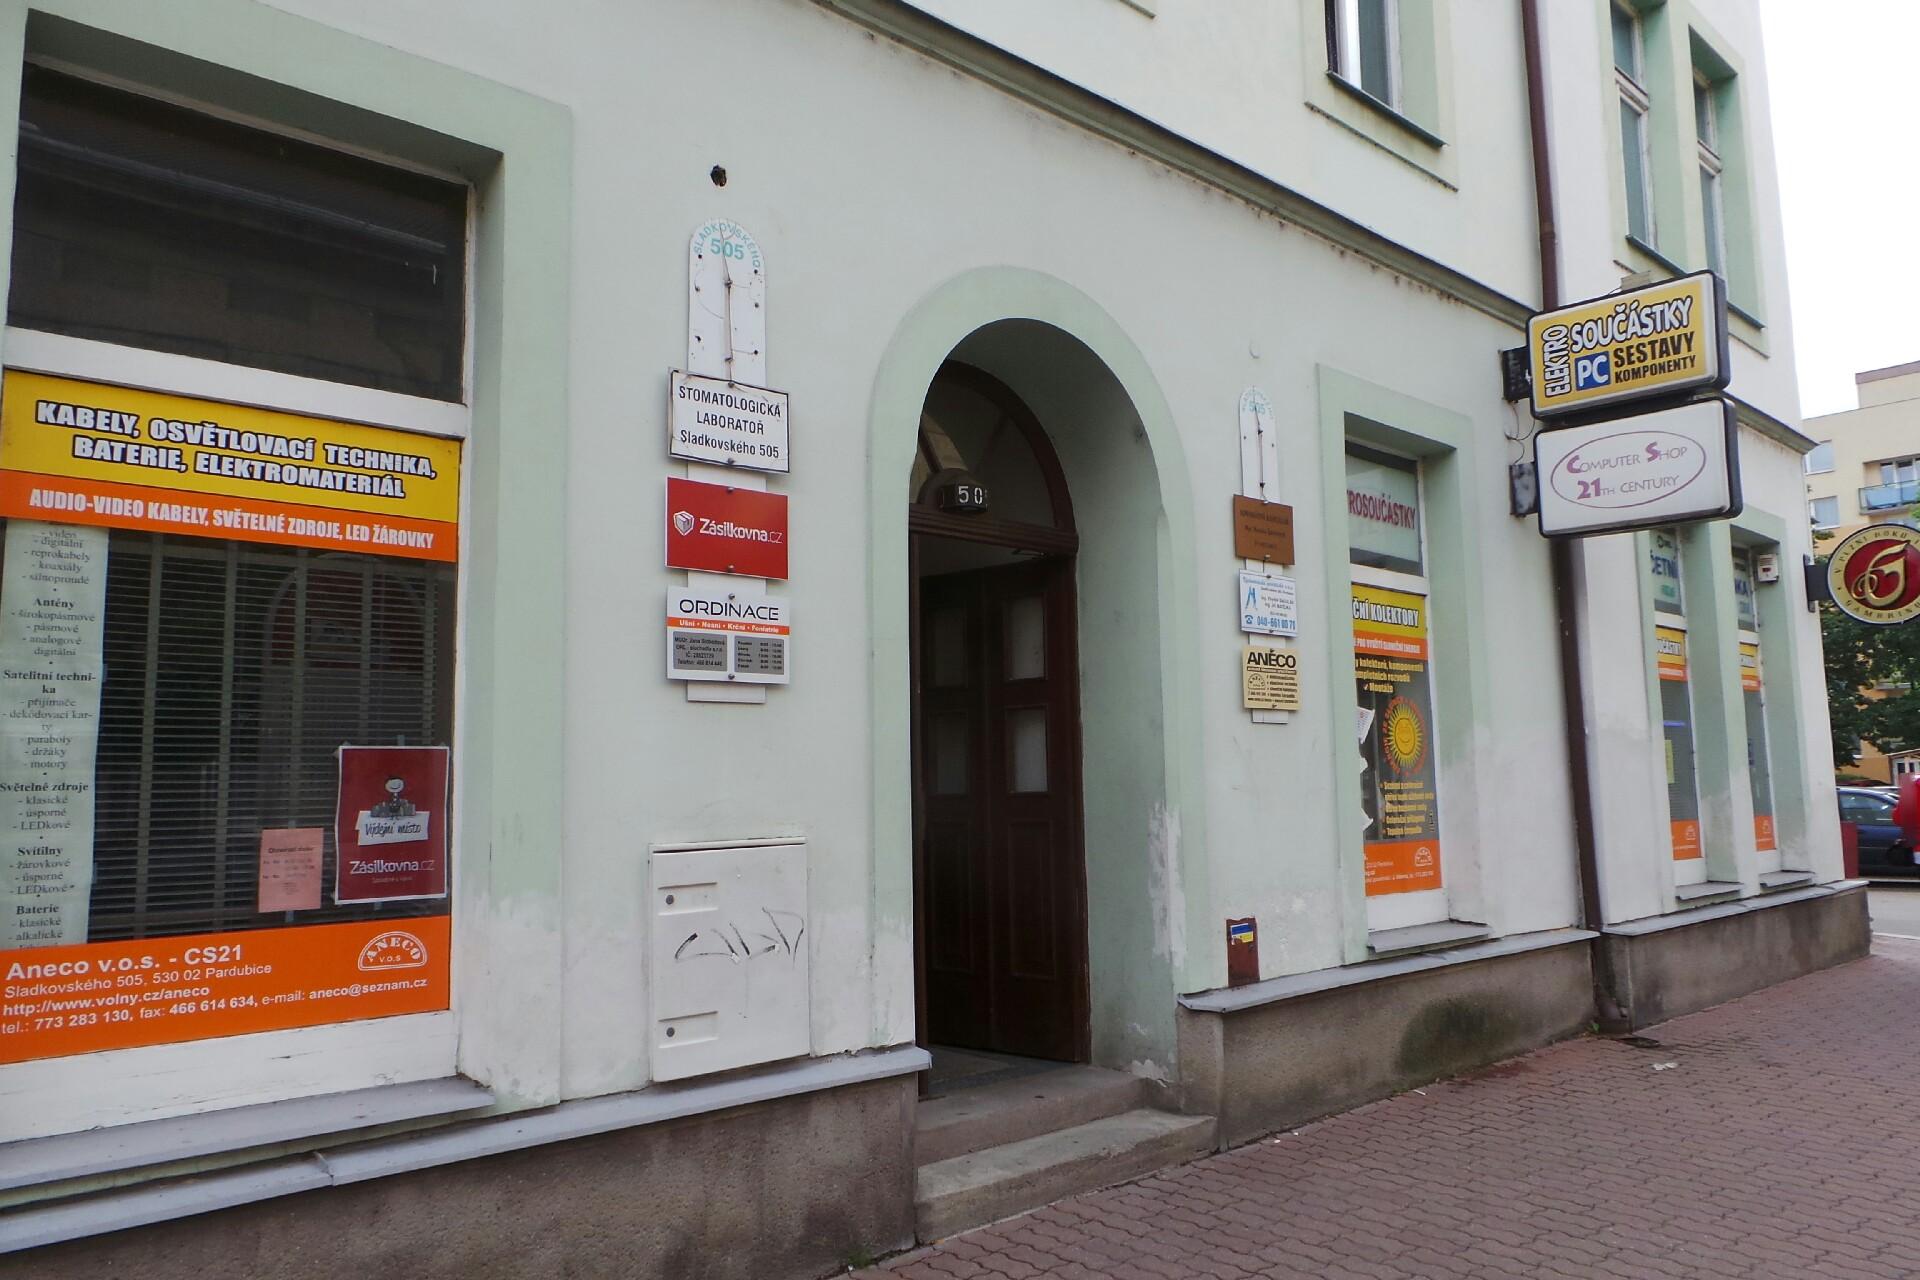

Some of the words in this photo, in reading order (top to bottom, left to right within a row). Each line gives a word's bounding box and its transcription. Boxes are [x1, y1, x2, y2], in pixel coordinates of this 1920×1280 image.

[711, 238, 745, 260] 505
[1570, 295, 1693, 354] SOUČÁSTKY
[1542, 324, 1572, 398] ELEKTRO
[1614, 331, 1695, 368] SESTAVY
[1577, 354, 1609, 388] PC
[1614, 355, 1696, 384] KOMPONENTY
[679, 385, 781, 418] STOMATOLOGICKÁ
[696, 410, 764, 435] LABORATOŘ
[36, 400, 140, 438] KABELY,
[324, 443, 437, 479] TECHNIKA,
[681, 429, 756, 456] Sladkovského
[759, 444, 779, 459] 505
[73, 435, 188, 473] BATERIE,
[194, 450, 406, 499] ELEKTROMATERIÁL
[1566, 453, 1641, 474] COMPUTER
[1645, 441, 1688, 463] SHOP
[1619, 475, 1680, 494] CENTURY
[29, 488, 144, 518] AUDIO-VIDEO
[148, 502, 209, 526] KABELY,
[212, 508, 286, 533] SVĚTELNÉ
[287, 517, 343, 541] ZDROJE,
[346, 524, 370, 542] LED
[373, 524, 434, 549] ŽÁROVKY
[1346, 489, 1416, 529] ROSOUČÁSTKY
[31, 549, 90, 563] reprokabely
[35, 598, 75, 611] Antény
[679, 599, 779, 621] ORDINACE
[1370, 602, 1419, 628] KOLEKTORY
[2, 669, 53, 681] Satelitní
[42, 684, 56, 694] ka
[0, 782, 50, 793] Světelné
[52, 782, 89, 794] zdroje
[21, 820, 72, 831] LEDkové
[17, 846, 64, 857] Svítilny
[16, 903, 60, 915] Baterie
[5, 960, 90, 981] Aneco
[98, 955, 161, 973] v.o.s.
[184, 944, 242, 966] CS21
[365, 937, 422, 964] ANECO
[4, 977, 112, 999] Sladkovského
[152, 971, 179, 984] 530
[183, 969, 201, 981] 02
[205, 964, 272, 979] Pardubice
[1, 1020, 30, 1035] tel.:
[34, 1017, 64, 1032] 773
[69, 1013, 98, 1028] 283
[103, 1009, 134, 1023] 130,
[139, 1007, 167, 1020] fax:
[169, 1002, 196, 1016] 466
[199, 998, 226, 1012] 614
[229, 994, 258, 1009] 634,
[261, 990, 305, 1006] e-mail:
[308, 977, 428, 1000] aneco@seznam.cz
[2, 986, 210, 1016] http://www.volny.cz/aneco
